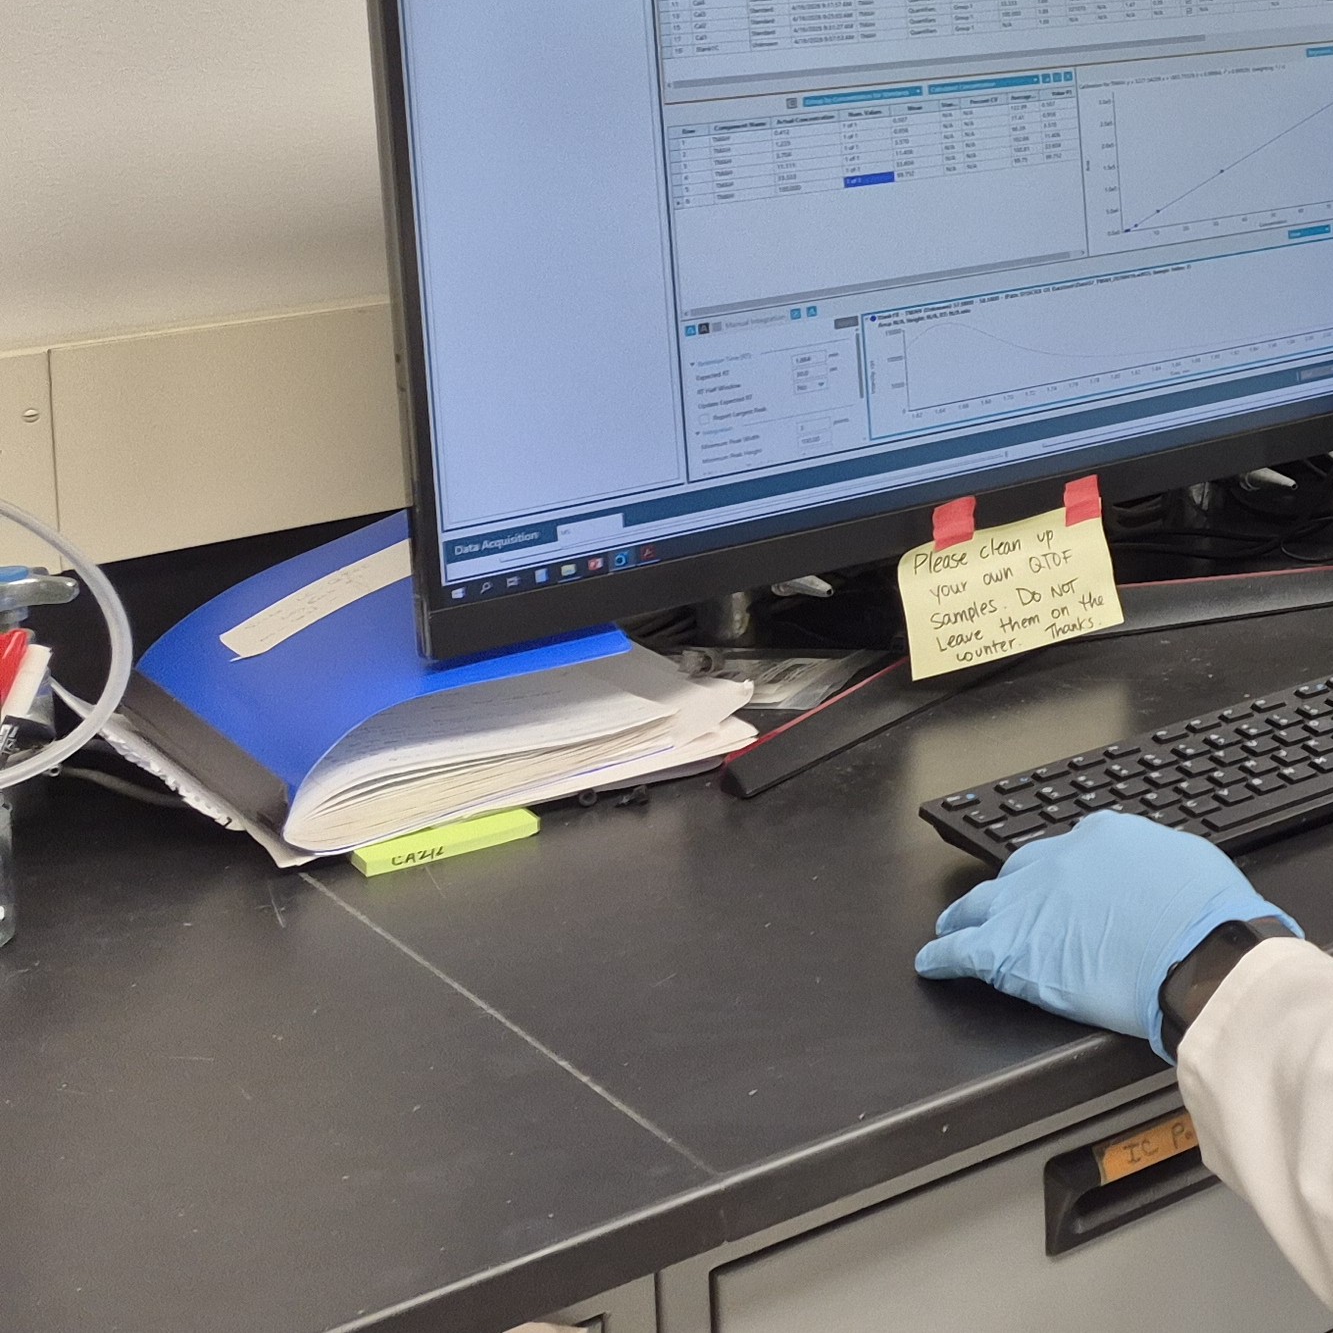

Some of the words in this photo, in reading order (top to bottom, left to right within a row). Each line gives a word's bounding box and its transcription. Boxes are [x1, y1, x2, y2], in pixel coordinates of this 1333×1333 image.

[455, 543, 480, 556] Data
[481, 530, 540, 551] Acquisition
[913, 551, 968, 575] Please
[979, 537, 1022, 559] clean
[1036, 529, 1054, 548] up
[929, 580, 968, 605] your
[982, 566, 1014, 586] own
[1028, 549, 1073, 574] QTOF
[1015, 586, 1042, 607] Do
[1050, 578, 1080, 598] NOT
[936, 628, 984, 653] Leave
[1000, 613, 1040, 634] them
[1050, 605, 1070, 620] on
[1078, 591, 1105, 612] the
